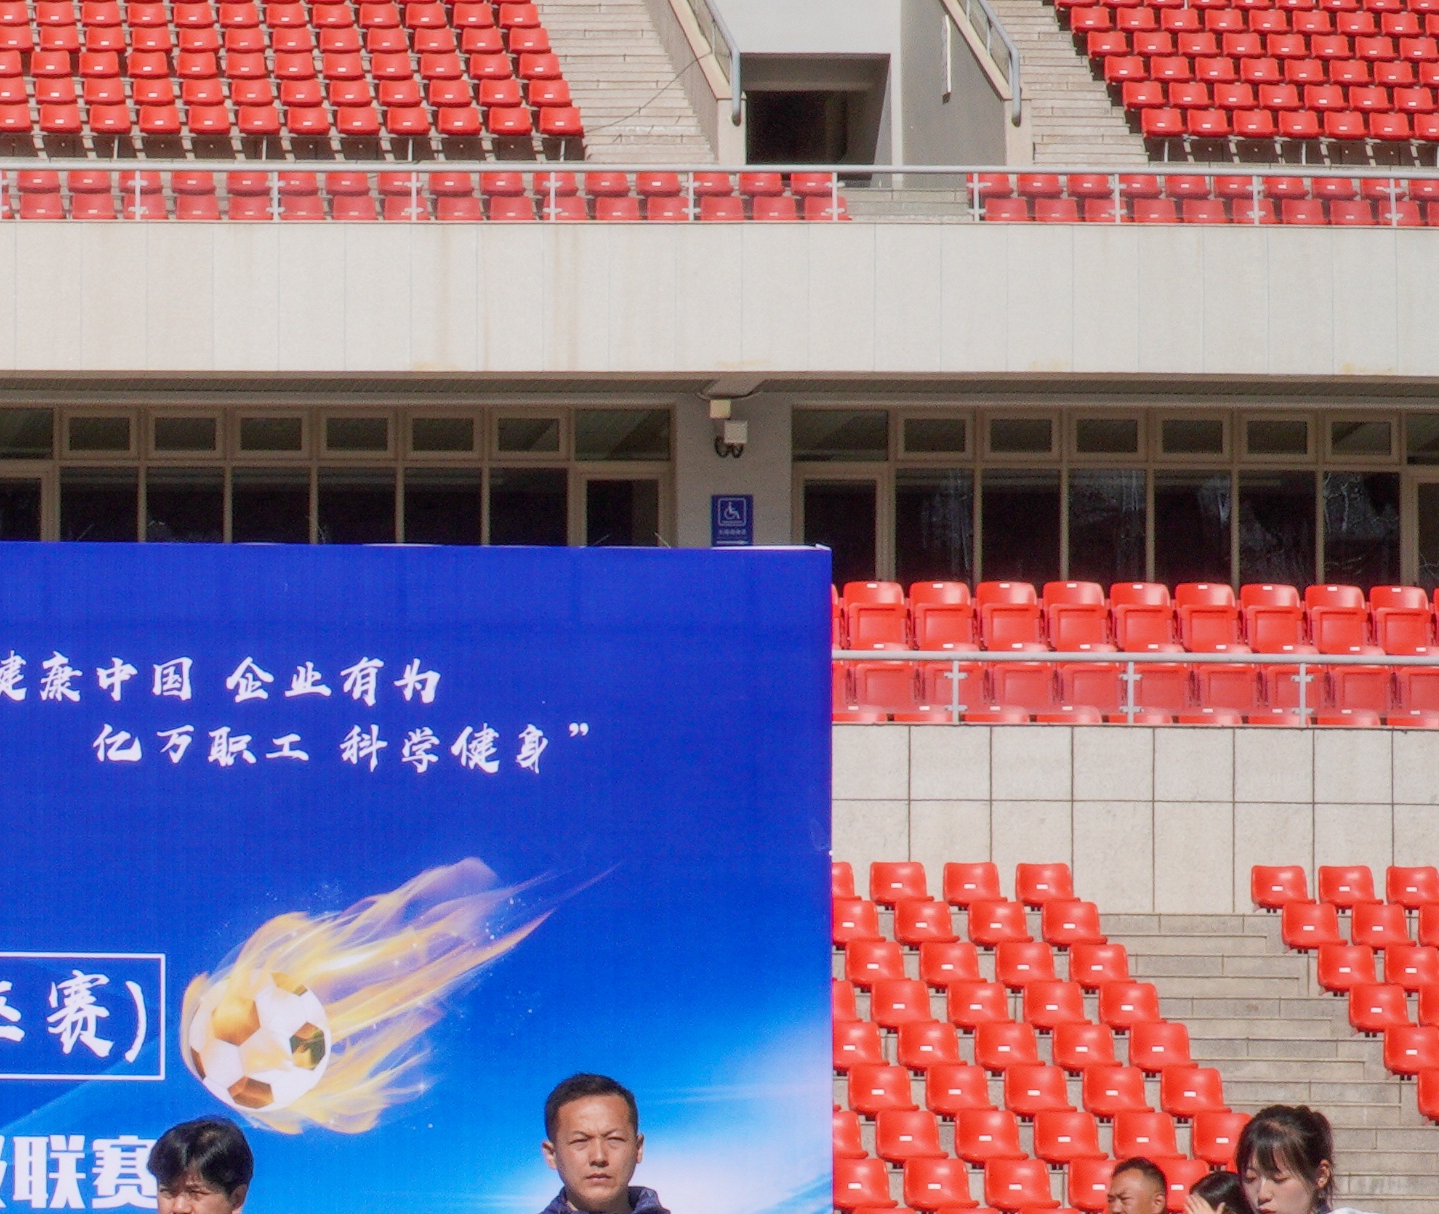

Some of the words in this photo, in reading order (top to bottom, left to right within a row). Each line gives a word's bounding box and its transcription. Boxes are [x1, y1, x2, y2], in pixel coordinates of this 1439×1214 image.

[226, 656, 442, 706] 企业有为
[92, 724, 310, 765] 亿万职工
